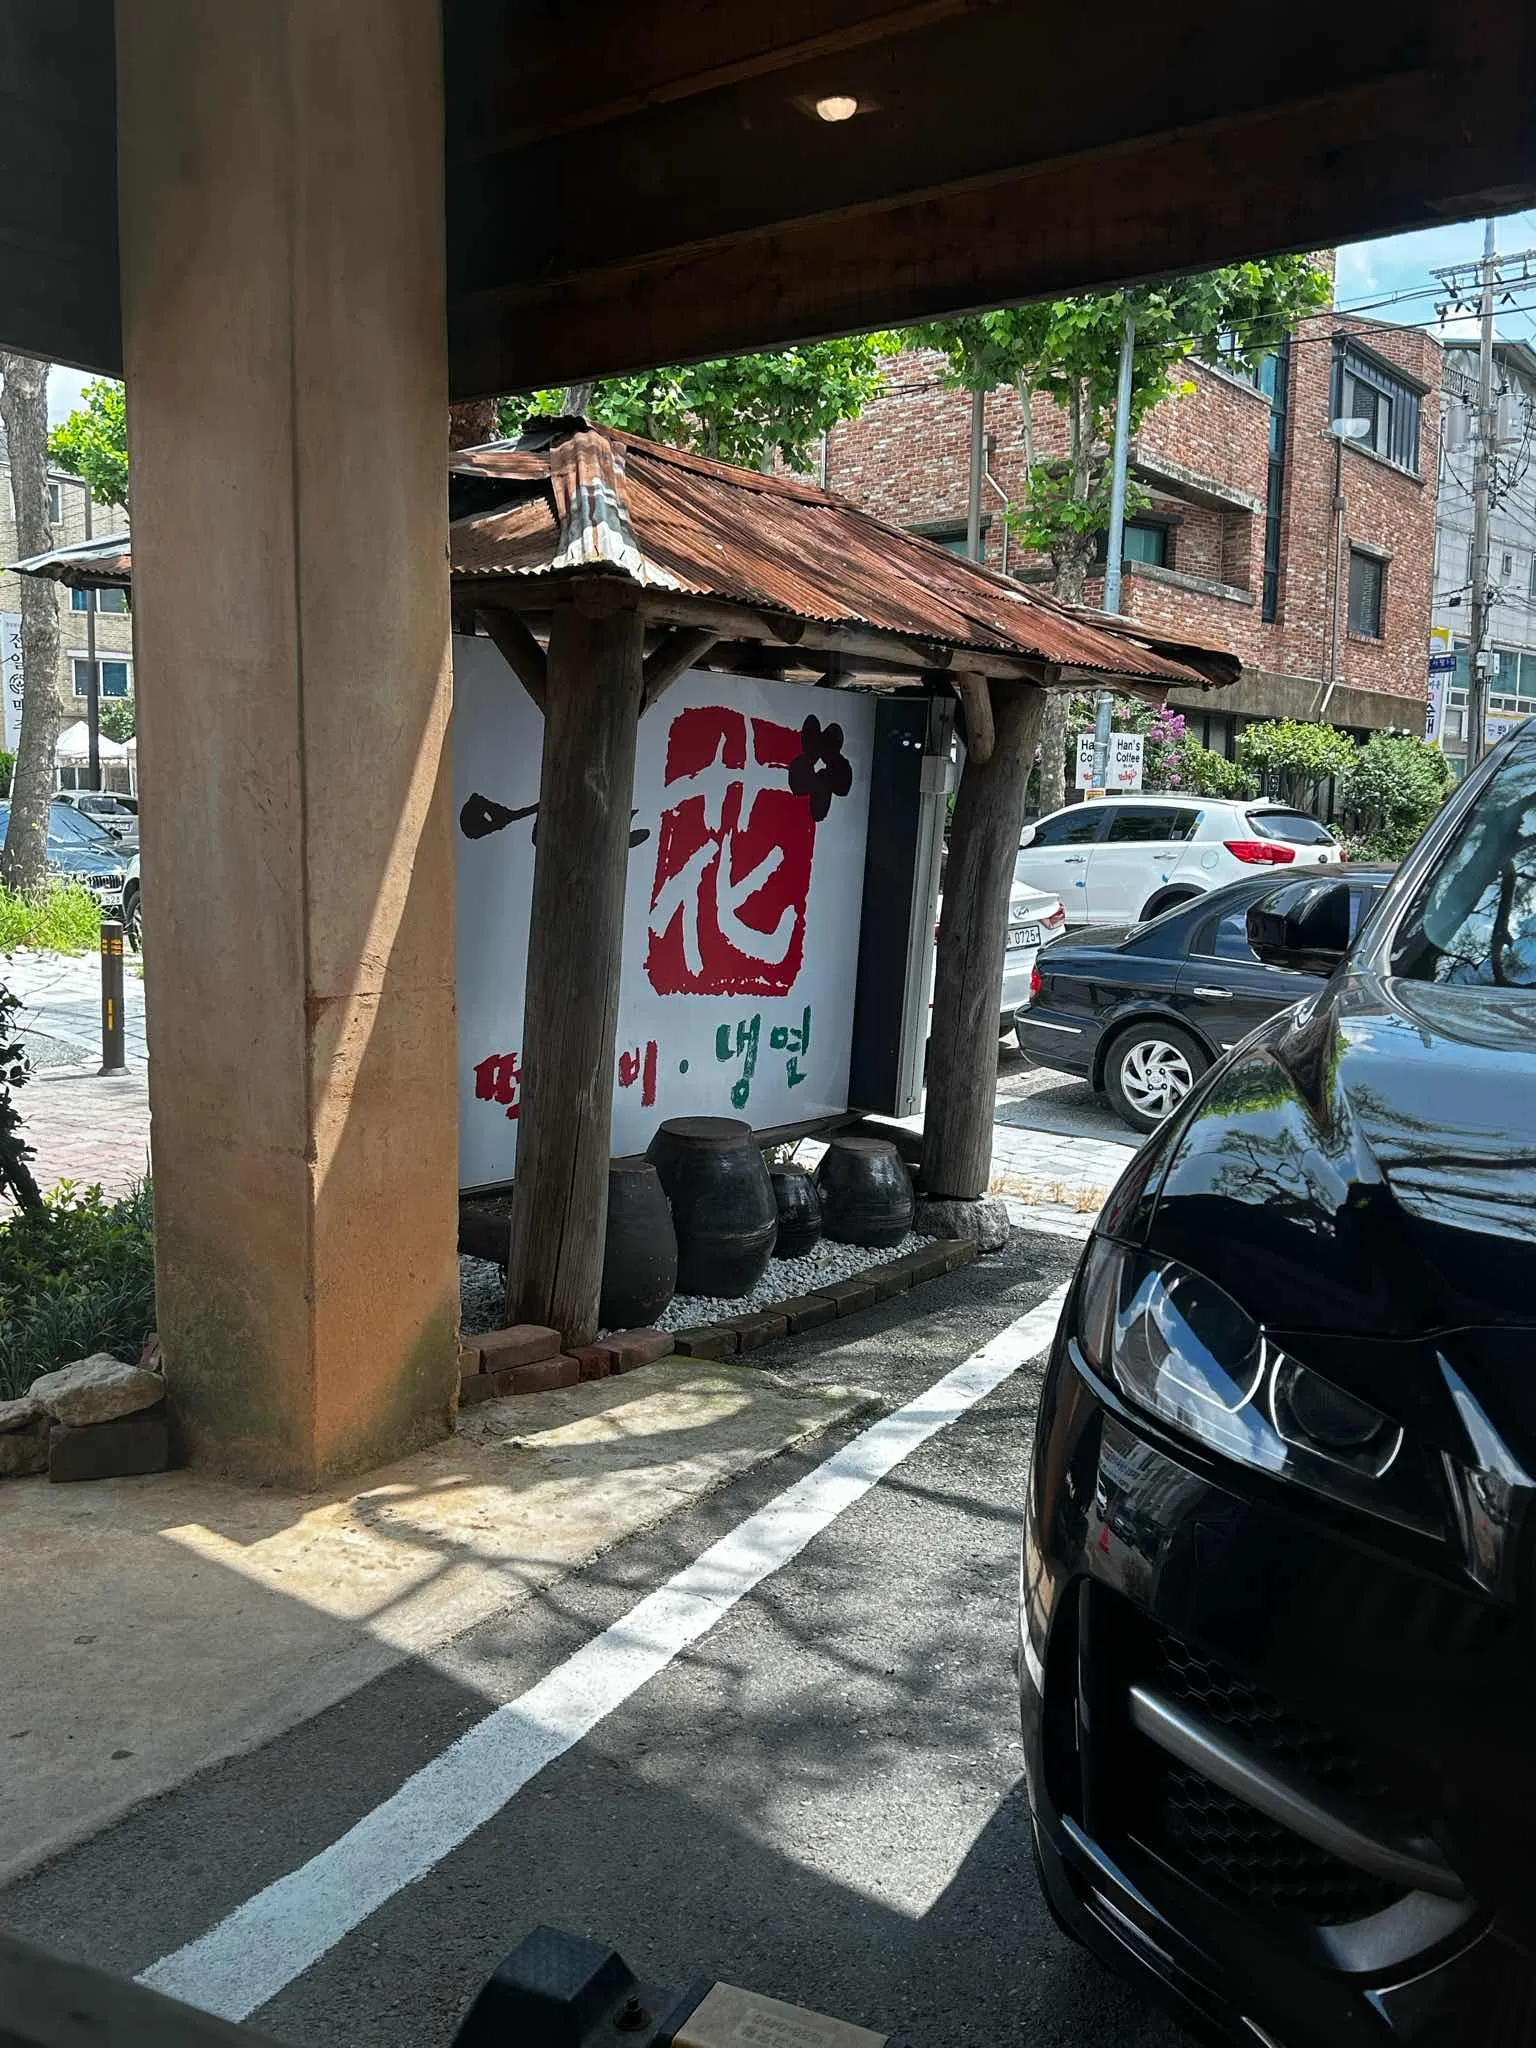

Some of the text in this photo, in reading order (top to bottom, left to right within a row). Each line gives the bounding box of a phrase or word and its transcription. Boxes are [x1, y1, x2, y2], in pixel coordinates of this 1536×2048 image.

[1117, 739, 1141, 751] Han's
[1116, 751, 1141, 763] Coffee
[1014, 929, 1036, 945] 0725
[715, 1005, 812, 1110] 냉면
